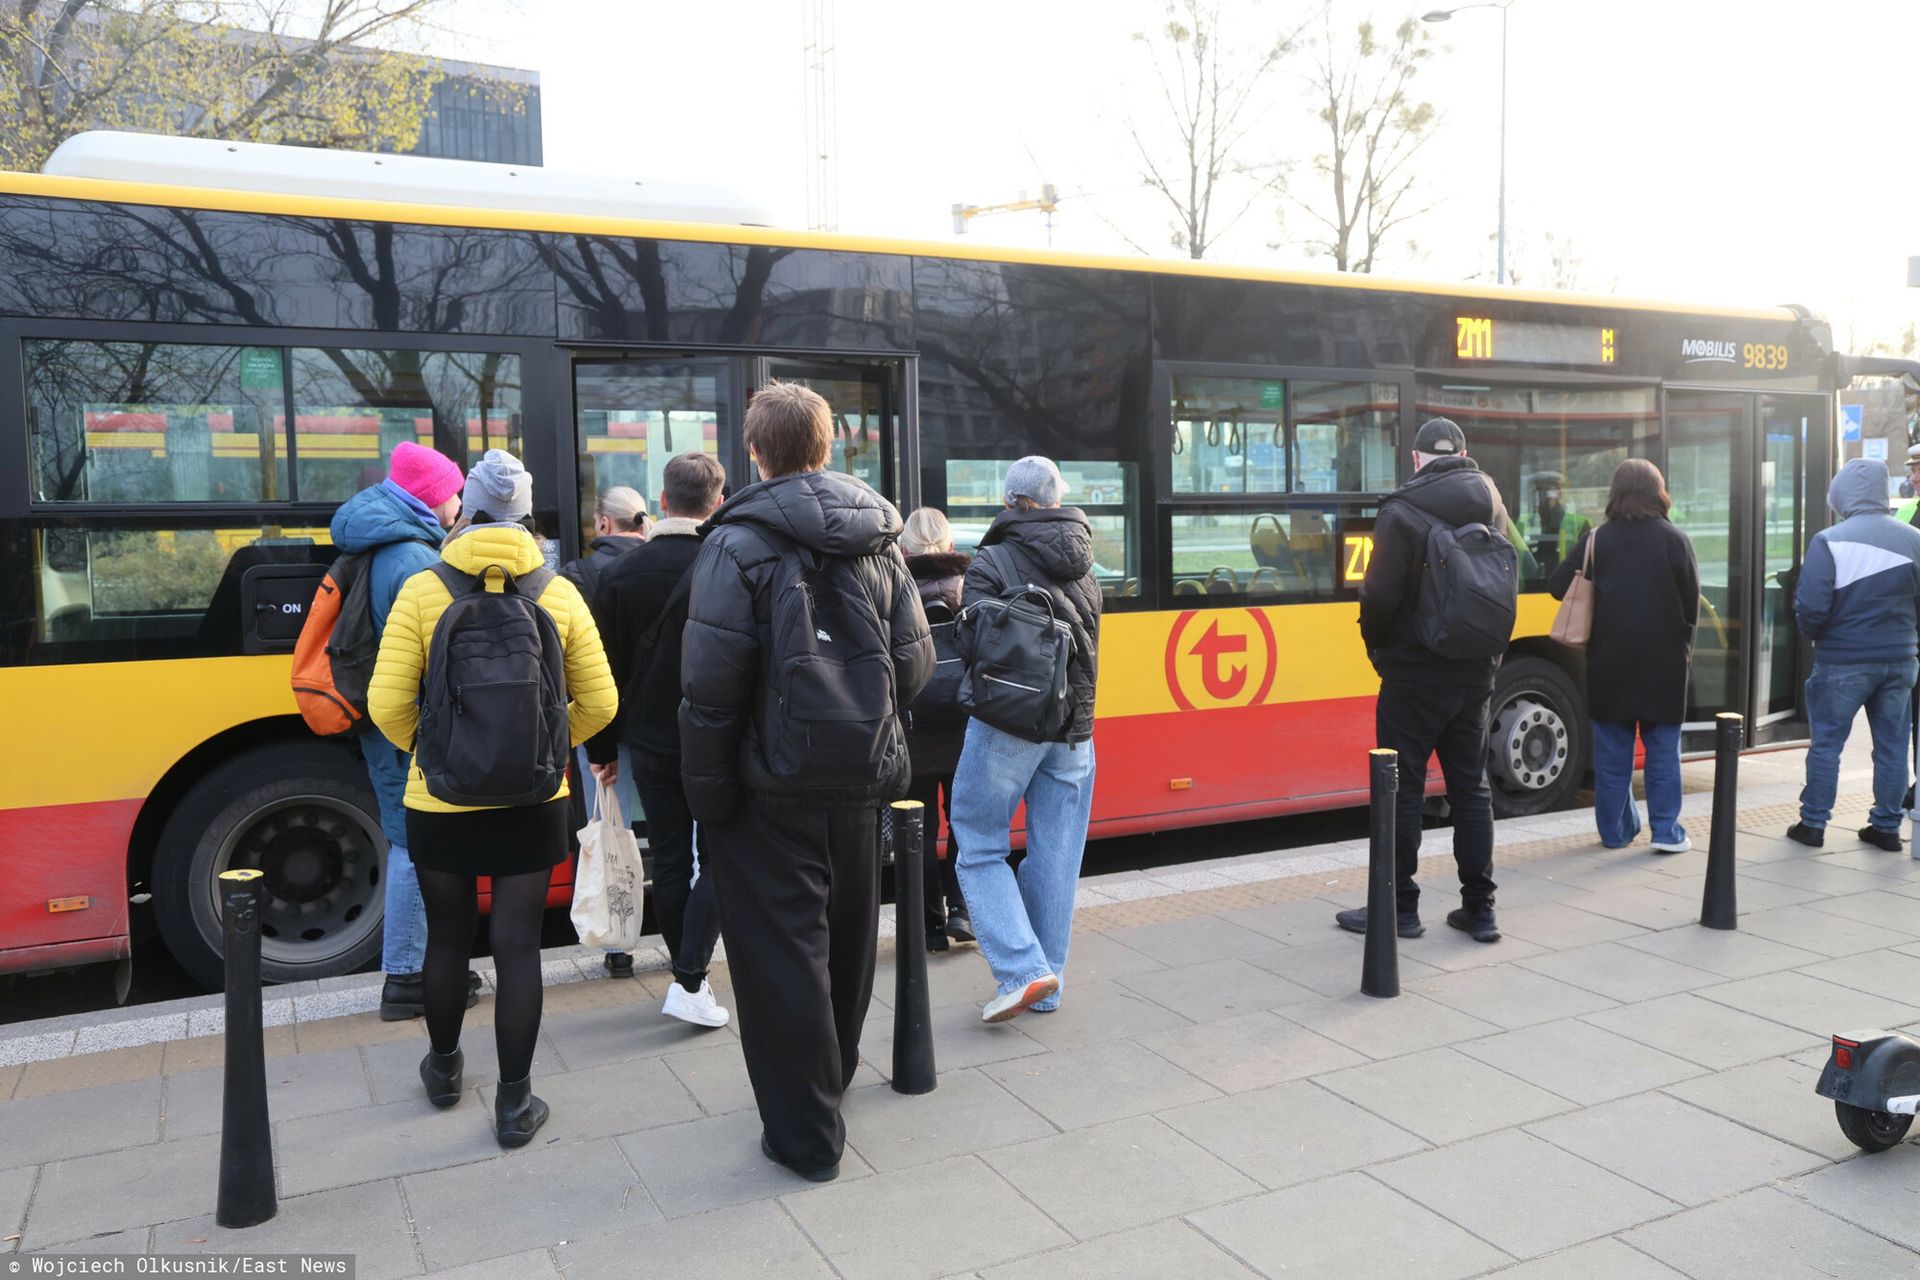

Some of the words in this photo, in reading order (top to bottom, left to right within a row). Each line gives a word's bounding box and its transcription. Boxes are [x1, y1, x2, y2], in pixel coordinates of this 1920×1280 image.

[1682, 339, 1737, 358] MOBILIS
[1743, 343, 1788, 370] 9839
[282, 603, 302, 614] ON
